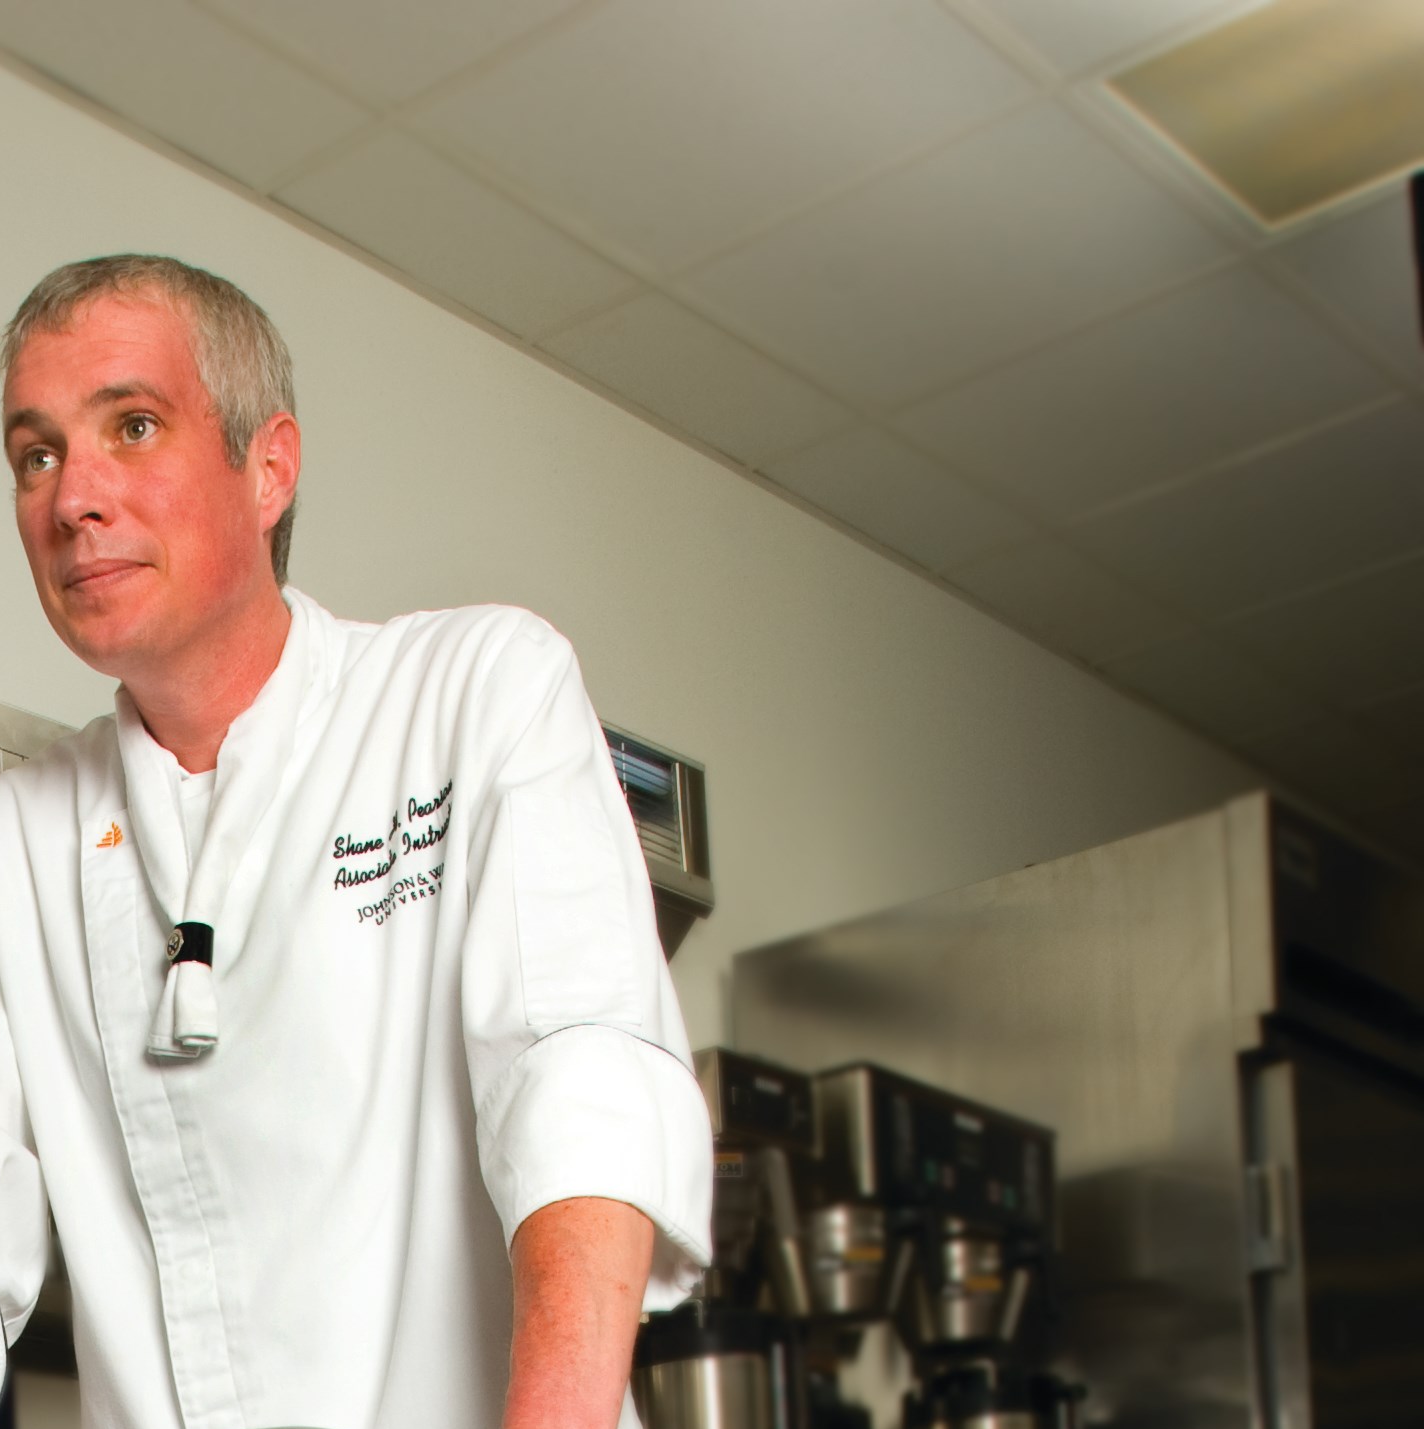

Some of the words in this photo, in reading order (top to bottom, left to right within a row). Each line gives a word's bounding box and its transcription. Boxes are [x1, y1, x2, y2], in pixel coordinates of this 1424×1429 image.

[333, 834, 384, 858] Shane
[357, 876, 416, 923] JOHNSON
[417, 872, 429, 885] &
